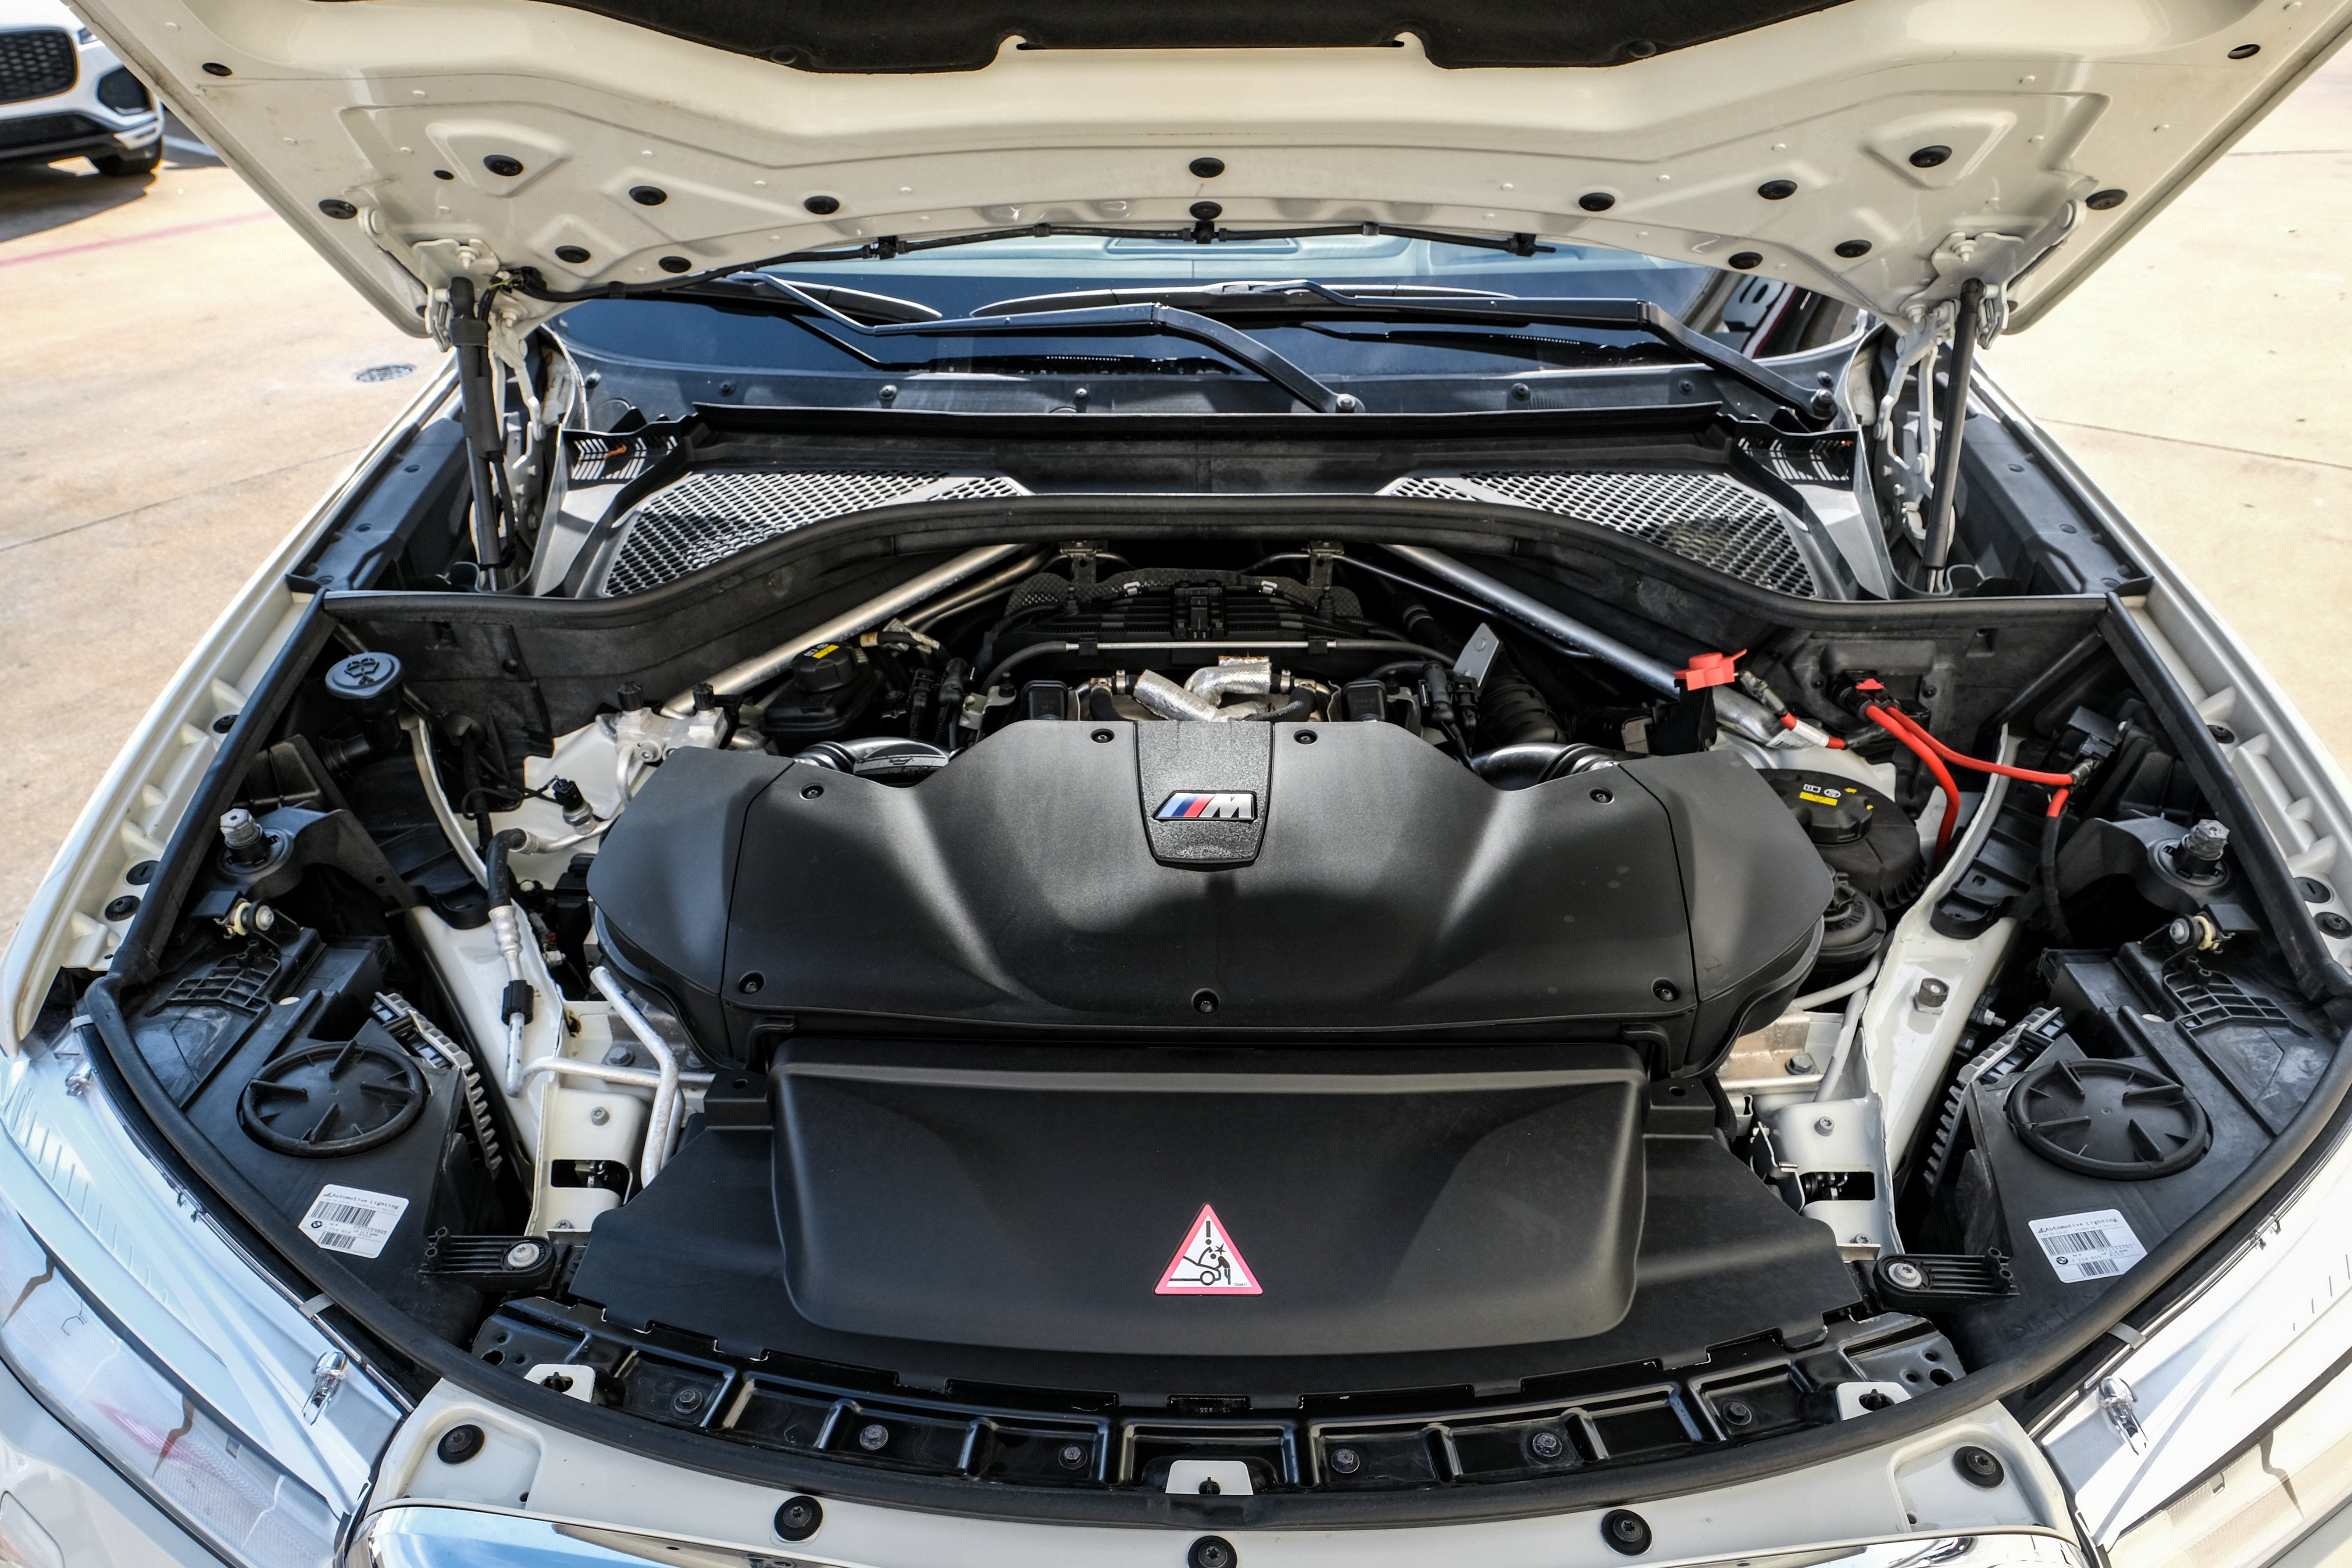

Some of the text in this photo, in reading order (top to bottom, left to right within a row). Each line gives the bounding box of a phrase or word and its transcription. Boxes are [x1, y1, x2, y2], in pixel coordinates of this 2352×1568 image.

[1199, 793, 1252, 818] M
[332, 1194, 368, 1203] Automotive
[370, 1200, 399, 1210] Lighting
[2045, 1222, 2083, 1232] Automotive
